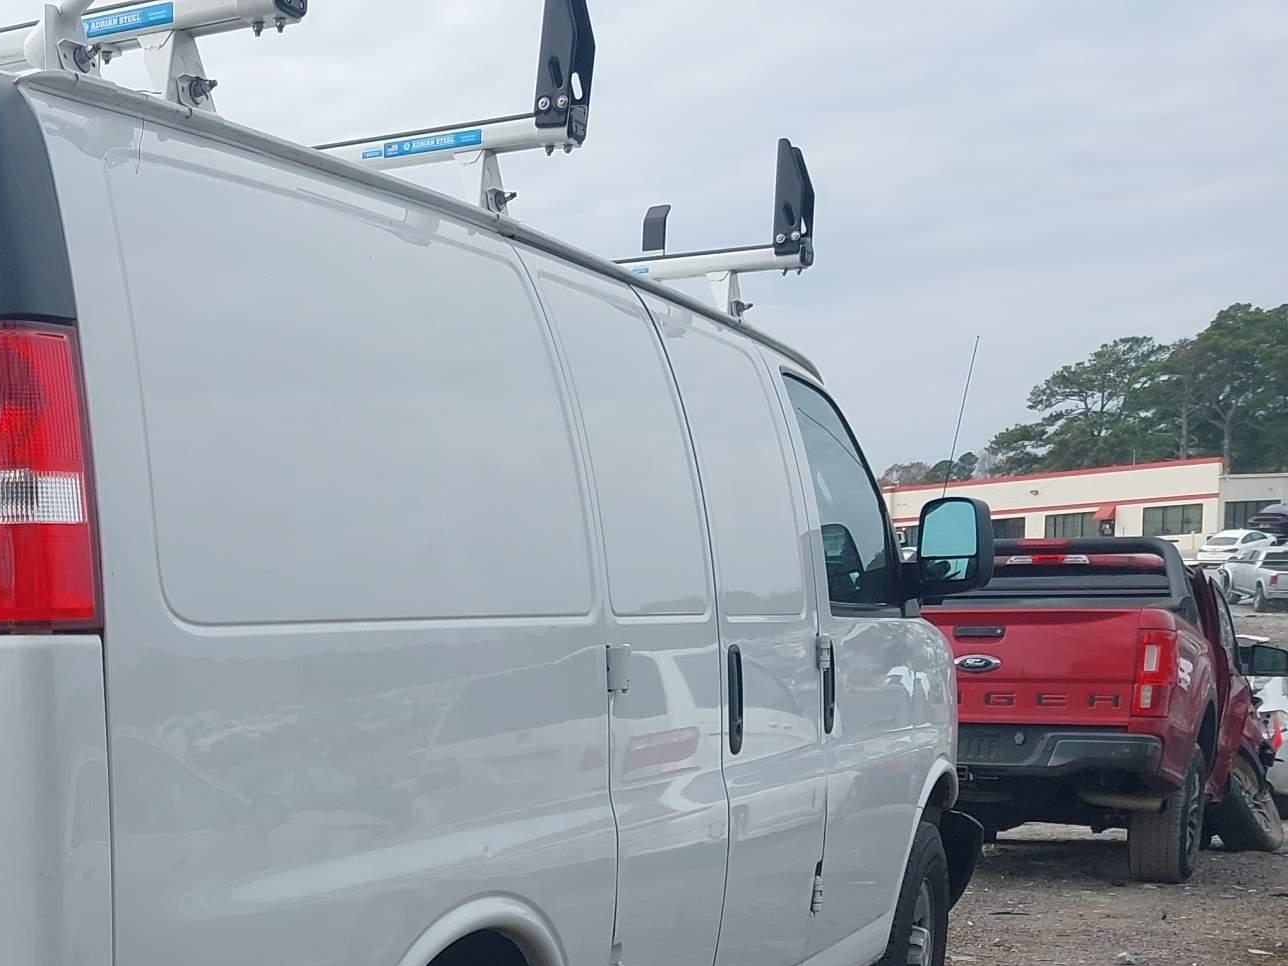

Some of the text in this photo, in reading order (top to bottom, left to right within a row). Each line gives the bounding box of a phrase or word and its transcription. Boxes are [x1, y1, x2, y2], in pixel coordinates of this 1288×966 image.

[90, 17, 118, 29] ADRIAN
[119, 13, 142, 25] STEEL
[958, 691, 1121, 709] GER
